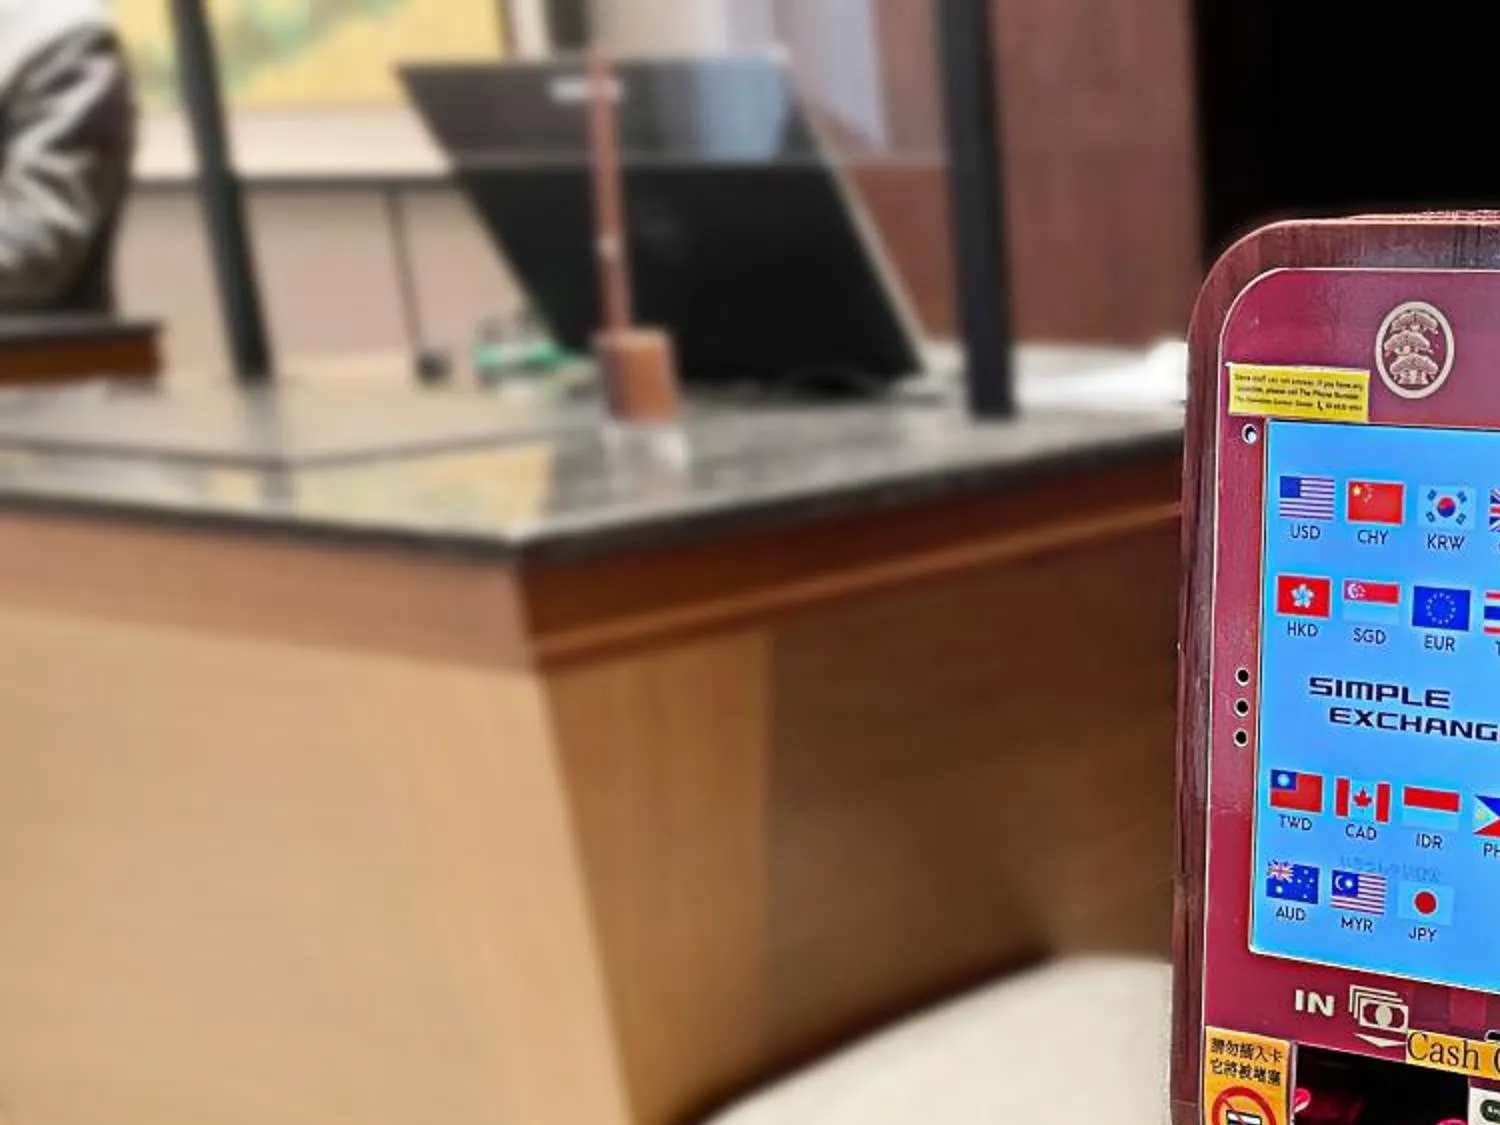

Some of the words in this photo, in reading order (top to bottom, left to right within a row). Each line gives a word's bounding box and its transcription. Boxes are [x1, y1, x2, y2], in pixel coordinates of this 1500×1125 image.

[1290, 525, 1321, 541] USD
[1357, 529, 1388, 546] CHY
[1427, 534, 1466, 552] KRW
[1287, 622, 1319, 638] HKD
[1353, 627, 1387, 645] SGD
[1424, 634, 1455, 652] EUR
[1309, 676, 1451, 710] SIMPLE
[1278, 813, 1313, 832] TWD
[1345, 823, 1378, 842] CAD
[1415, 832, 1443, 850] IDR
[1275, 905, 1307, 923] AUD
[1340, 916, 1374, 934] MYR
[1408, 926, 1438, 944] JPY
[1295, 989, 1335, 1017] IN
[1408, 1031, 1479, 1071] Cash
